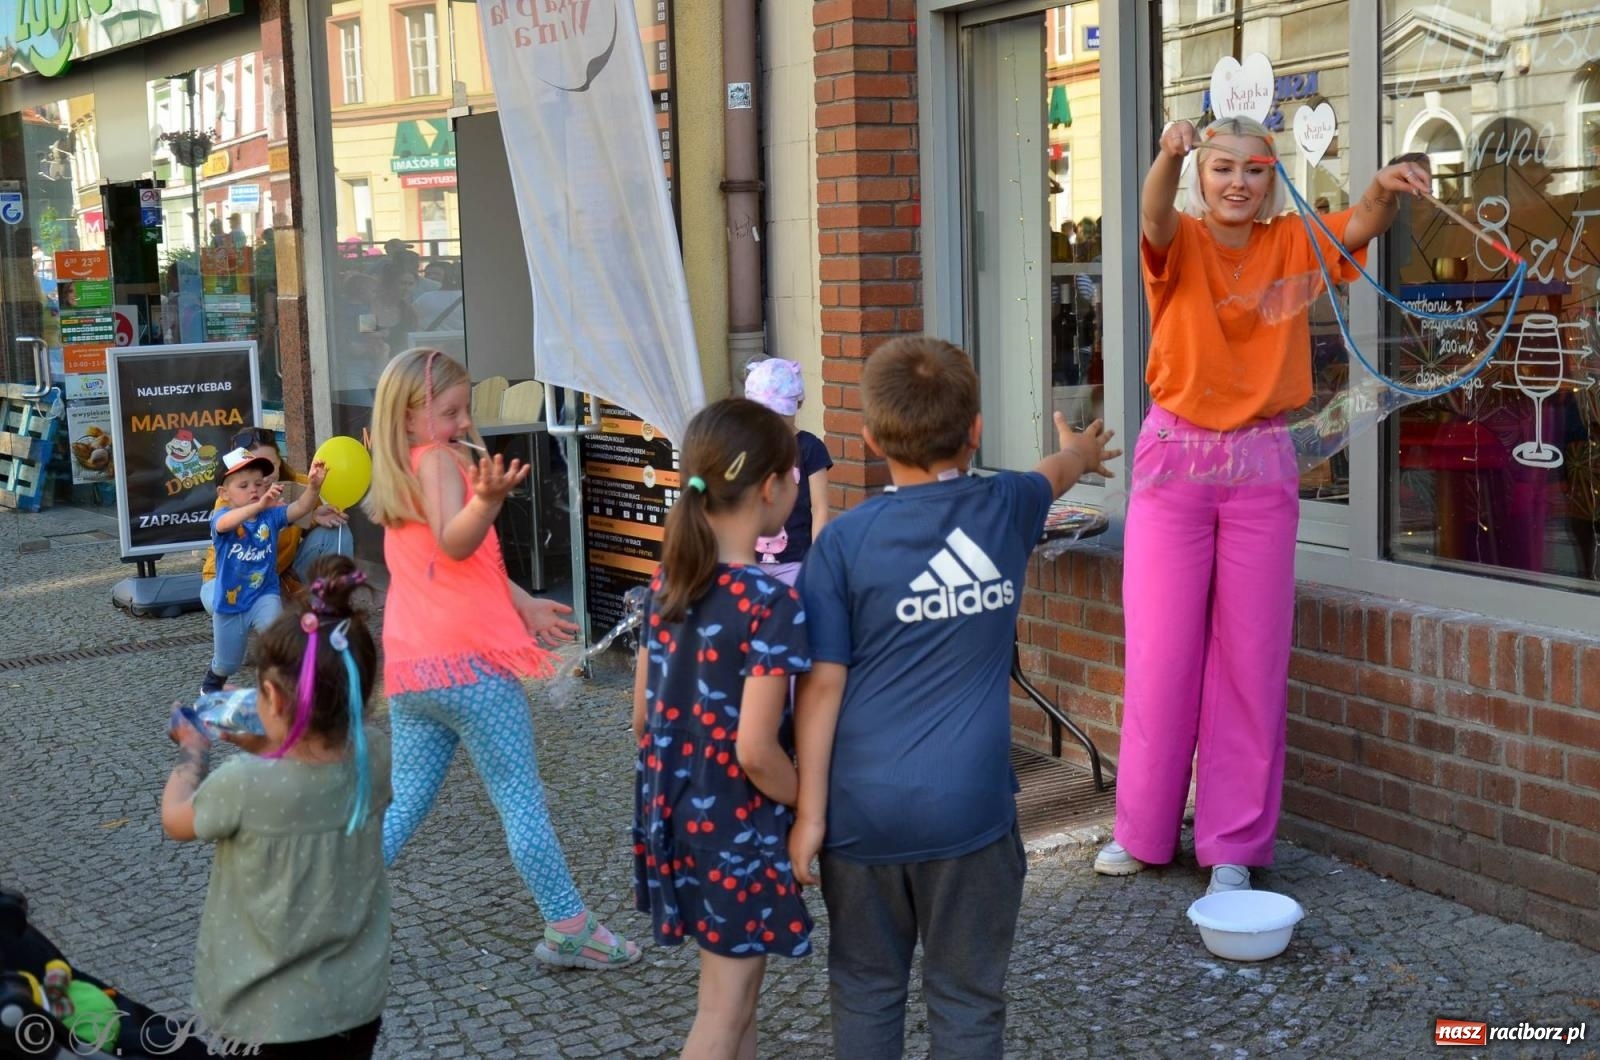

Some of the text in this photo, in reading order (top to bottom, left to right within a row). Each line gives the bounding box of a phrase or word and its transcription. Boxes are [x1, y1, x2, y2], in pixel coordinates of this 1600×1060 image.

[1231, 83, 1268, 103] Kapka
[1226, 99, 1256, 112] Wina
[1307, 122, 1332, 134] Kapka
[1466, 122, 1563, 171] wina
[1475, 195, 1511, 272] 8
[1438, 338, 1458, 355] 200
[137, 381, 232, 397] NAJLEPSZY KEBAB
[131, 408, 243, 432] MARMARA
[227, 543, 272, 561] Pokémn
[896, 579, 1014, 623] adidas
